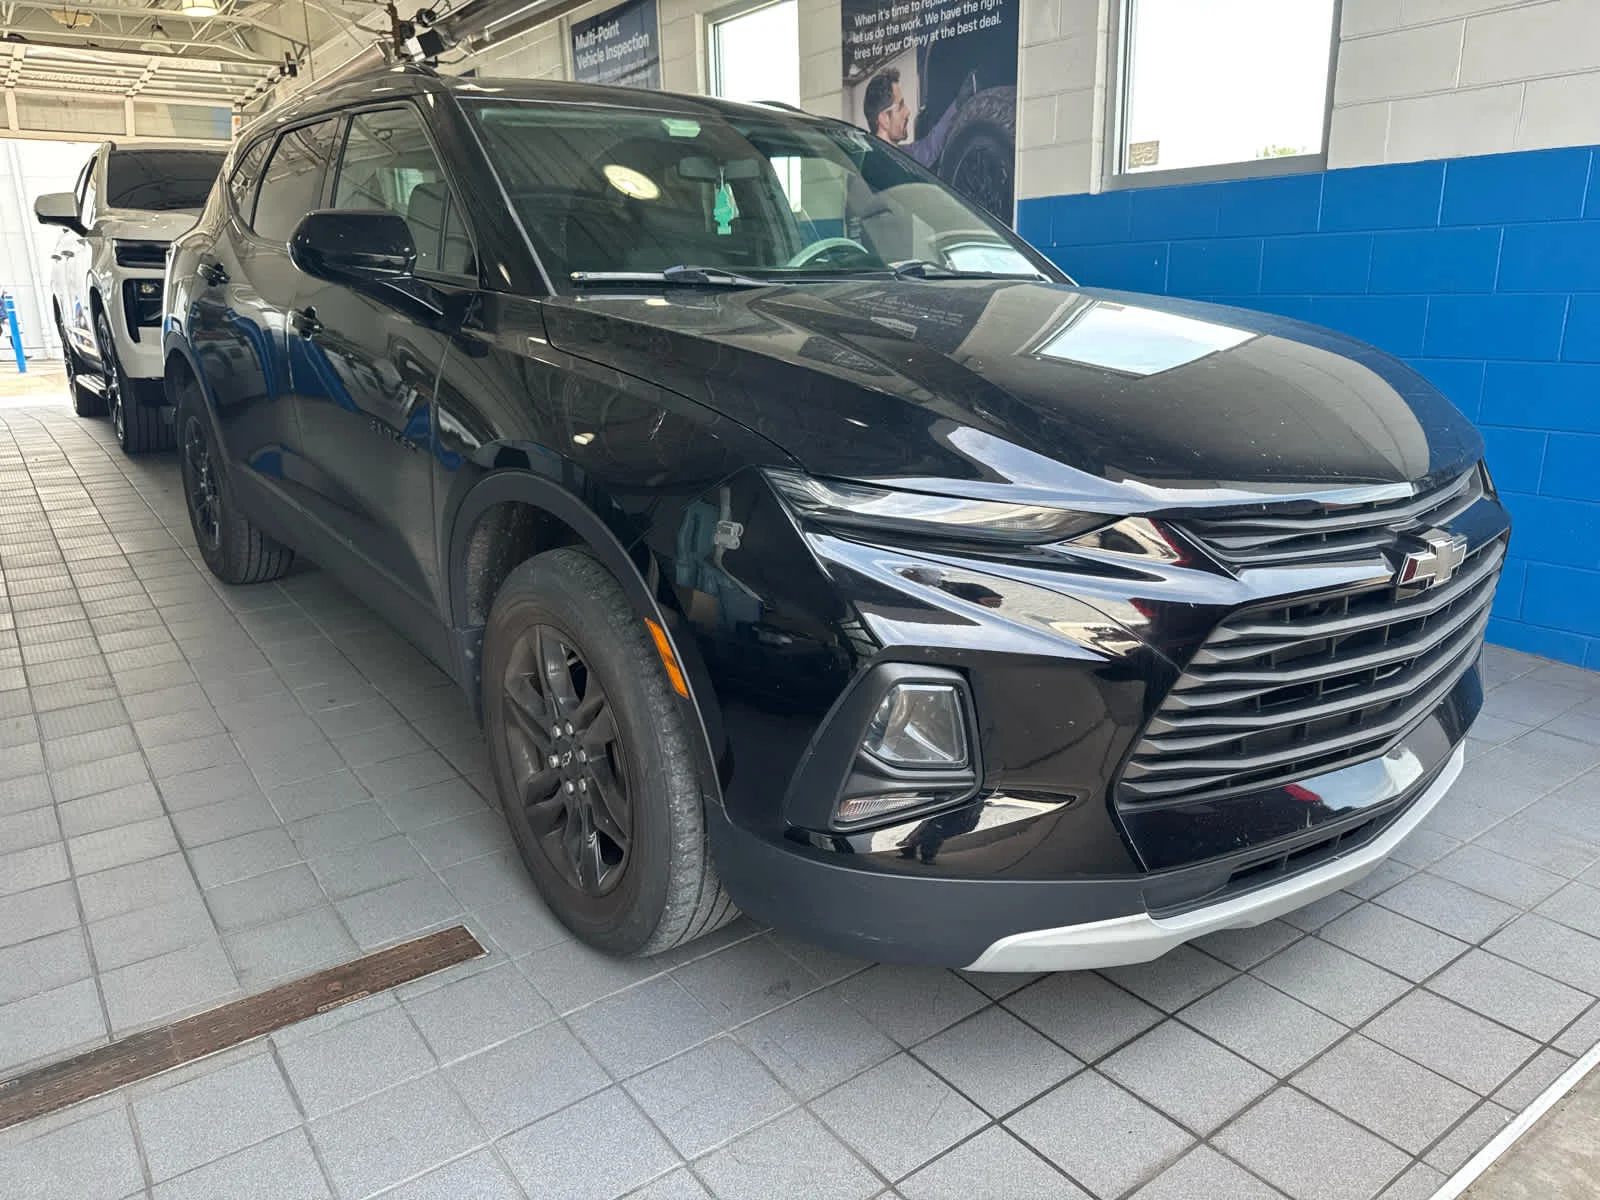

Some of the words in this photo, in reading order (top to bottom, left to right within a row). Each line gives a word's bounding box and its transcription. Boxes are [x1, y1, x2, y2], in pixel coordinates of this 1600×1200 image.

[852, 31, 863, 43] let
[864, 31, 874, 41] us
[874, 26, 885, 39] do
[886, 23, 900, 36] the
[900, 16, 924, 32] work.
[924, 11, 939, 25] We
[940, 7, 961, 21] have
[963, 1, 979, 15] the
[854, 13, 877, 27] When
[877, 8, 890, 22] it's
[891, 4, 910, 17] time
[911, 0, 920, 12] to
[575, 20, 620, 51] Multi-Point
[576, 48, 605, 70] Vehicle
[604, 32, 650, 61] Inspection
[854, 47, 871, 60] tires
[871, 43, 883, 56] for
[884, 40, 902, 56] your
[903, 34, 929, 49] Chevy
[929, 29, 939, 42] at
[940, 25, 955, 39] the
[957, 18, 978, 35] best
[979, 11, 1002, 29] deal.
